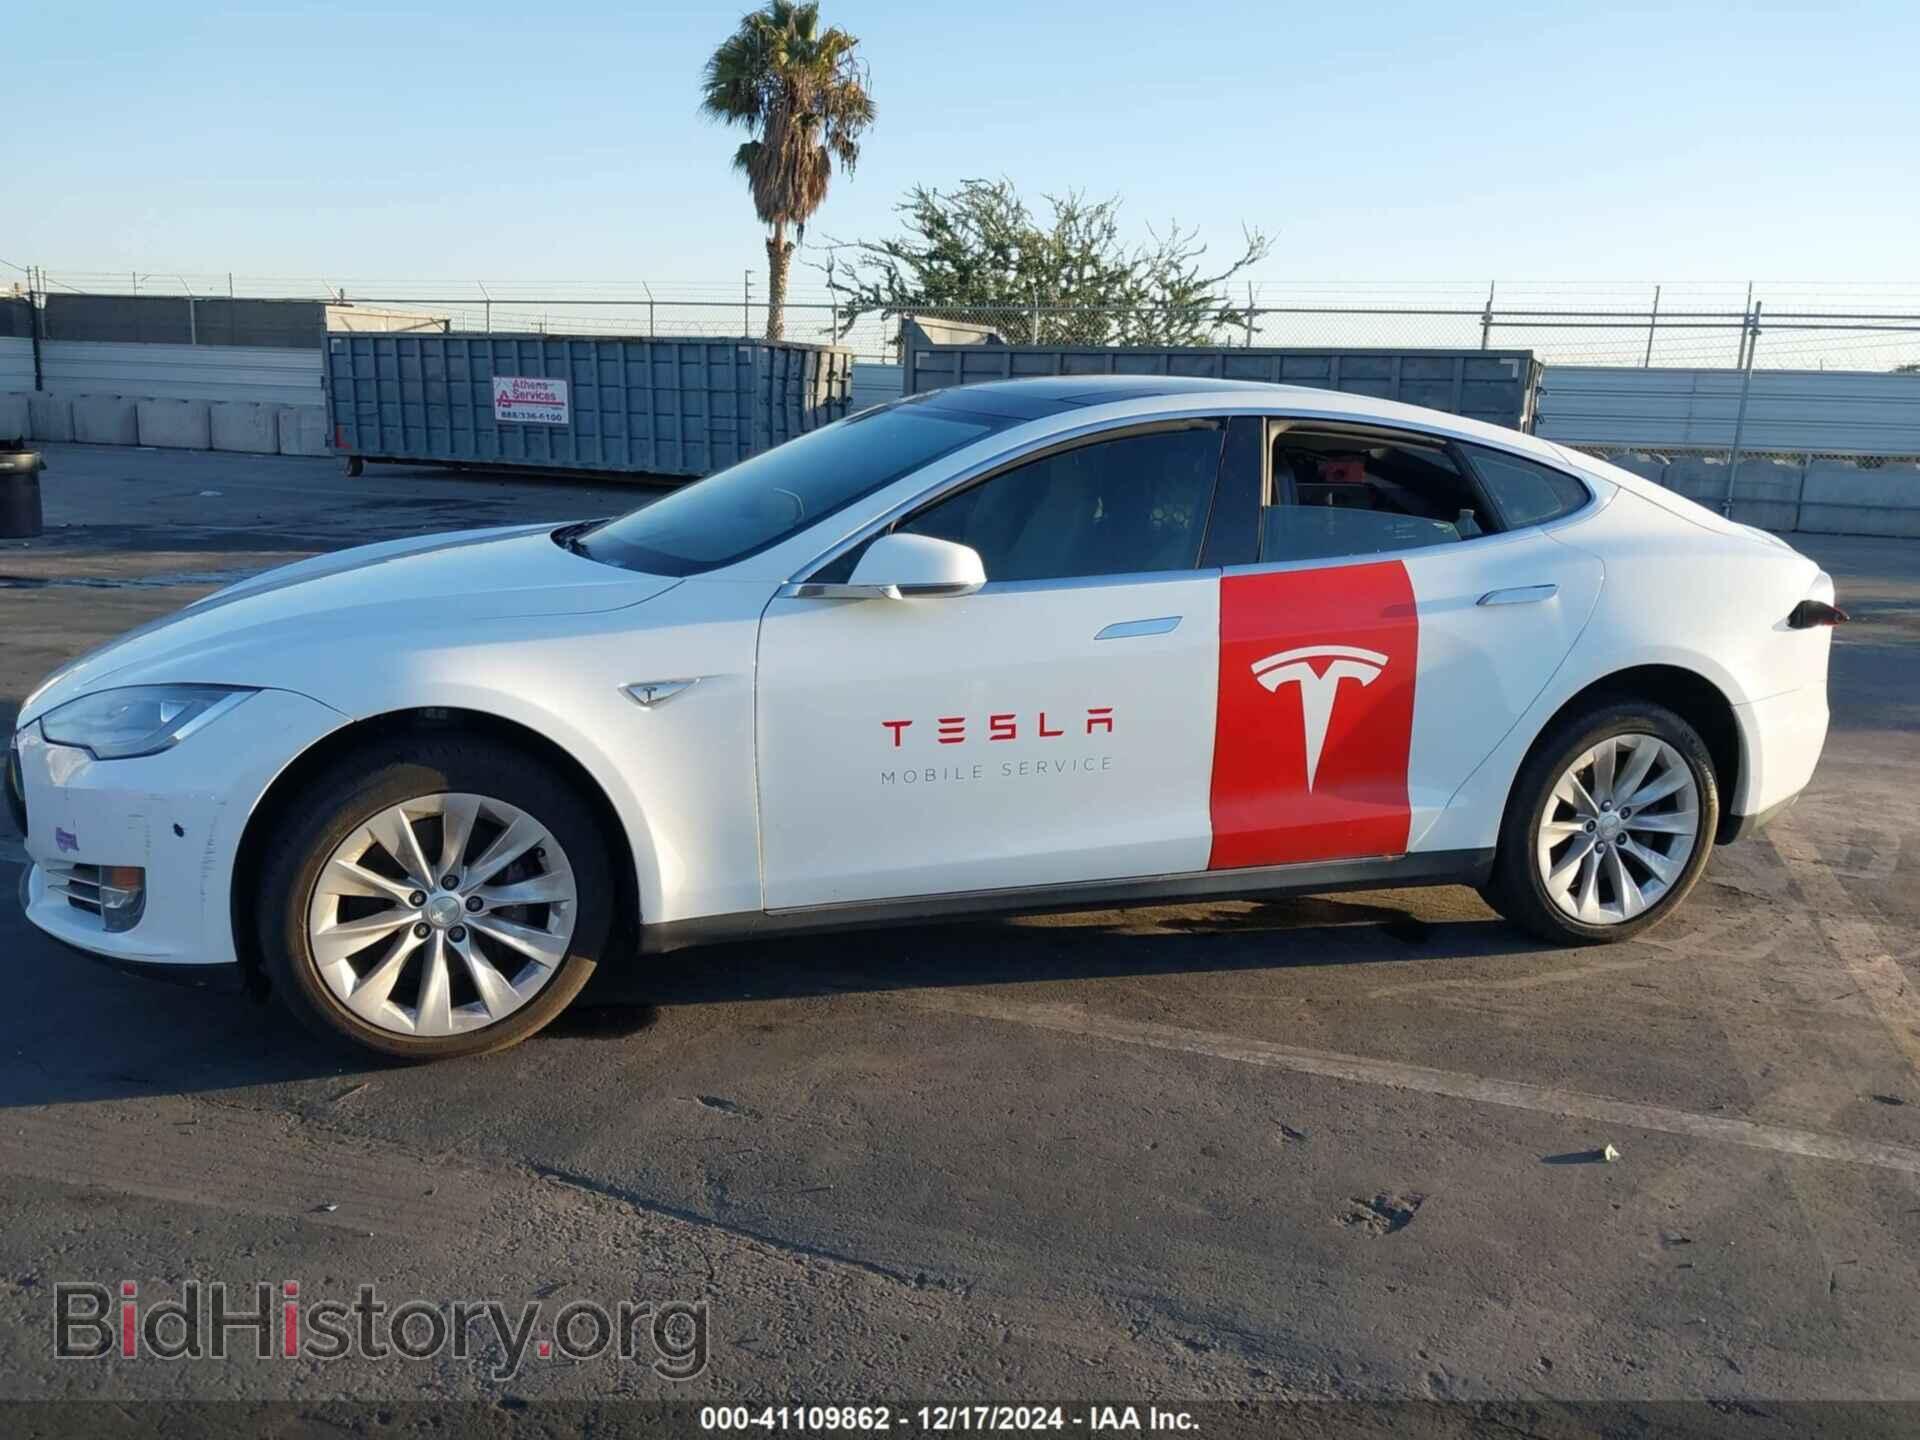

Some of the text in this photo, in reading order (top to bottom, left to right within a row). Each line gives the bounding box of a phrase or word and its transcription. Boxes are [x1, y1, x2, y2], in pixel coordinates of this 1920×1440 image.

[512, 379, 548, 390] Athens
[512, 389, 557, 401] Services
[881, 708, 1113, 747] TESLA
[881, 756, 1113, 785] MOBILE SERVICE
